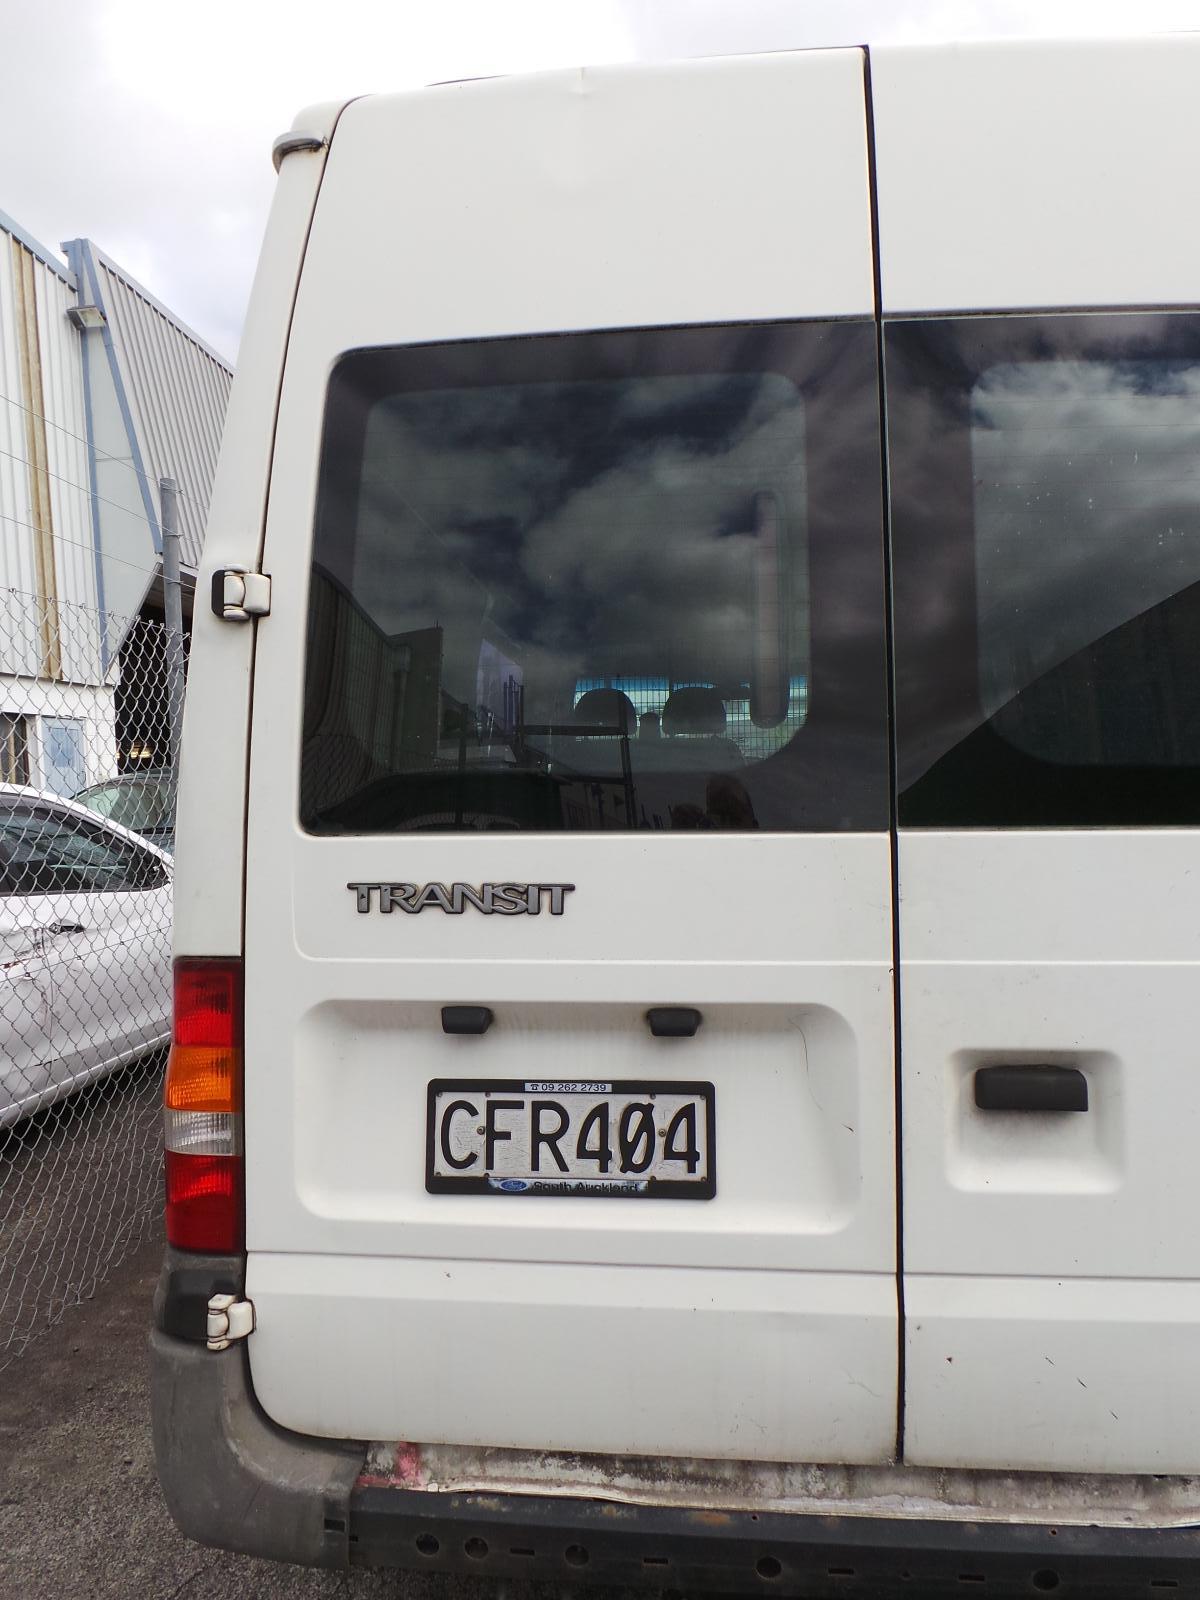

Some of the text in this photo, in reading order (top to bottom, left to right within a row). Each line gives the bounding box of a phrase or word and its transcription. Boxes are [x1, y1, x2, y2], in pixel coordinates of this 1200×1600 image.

[347, 882, 575, 915] TRANSIT
[541, 1083, 607, 1093] 09 262 2739
[440, 1100, 701, 1174] CFR404
[533, 1181, 572, 1193] South
